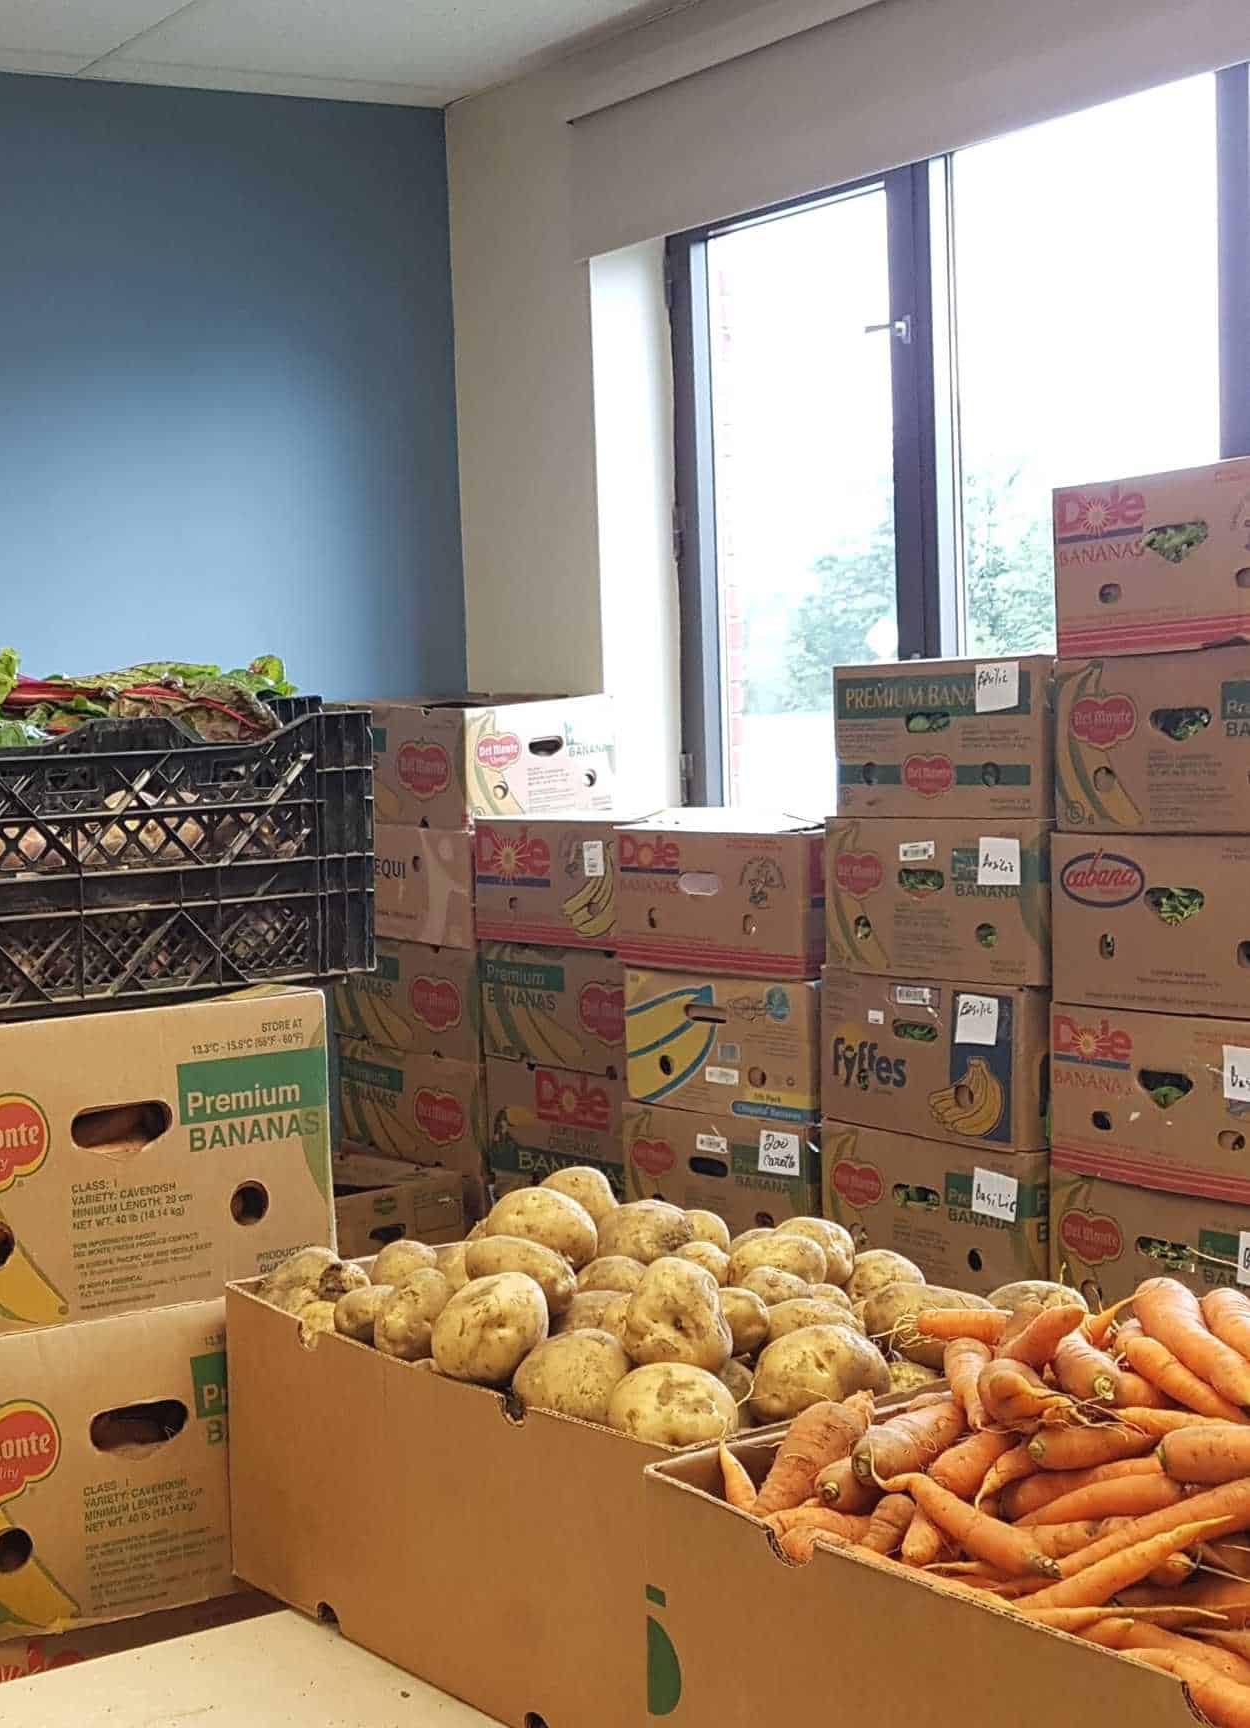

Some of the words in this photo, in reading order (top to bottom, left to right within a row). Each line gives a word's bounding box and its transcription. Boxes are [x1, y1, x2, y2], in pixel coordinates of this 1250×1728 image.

[1058, 541, 1145, 567] BANANAS
[845, 687, 924, 709] PREMIUM
[619, 833, 680, 869] Dole
[261, 1020, 290, 1033] STORE
[292, 1018, 303, 1029] AT
[1053, 1015, 1133, 1061] Dole
[187, 1083, 300, 1118] Premium
[189, 1111, 320, 1152] BANANAS
[71, 1180, 110, 1194] CLASS:
[72, 1190, 117, 1207] VARIETY:
[120, 1181, 176, 1201] CAVENDISH
[72, 1203, 117, 1219] MINIMUM
[72, 1219, 92, 1231] NET
[130, 1477, 188, 1499] CAVENDISH
